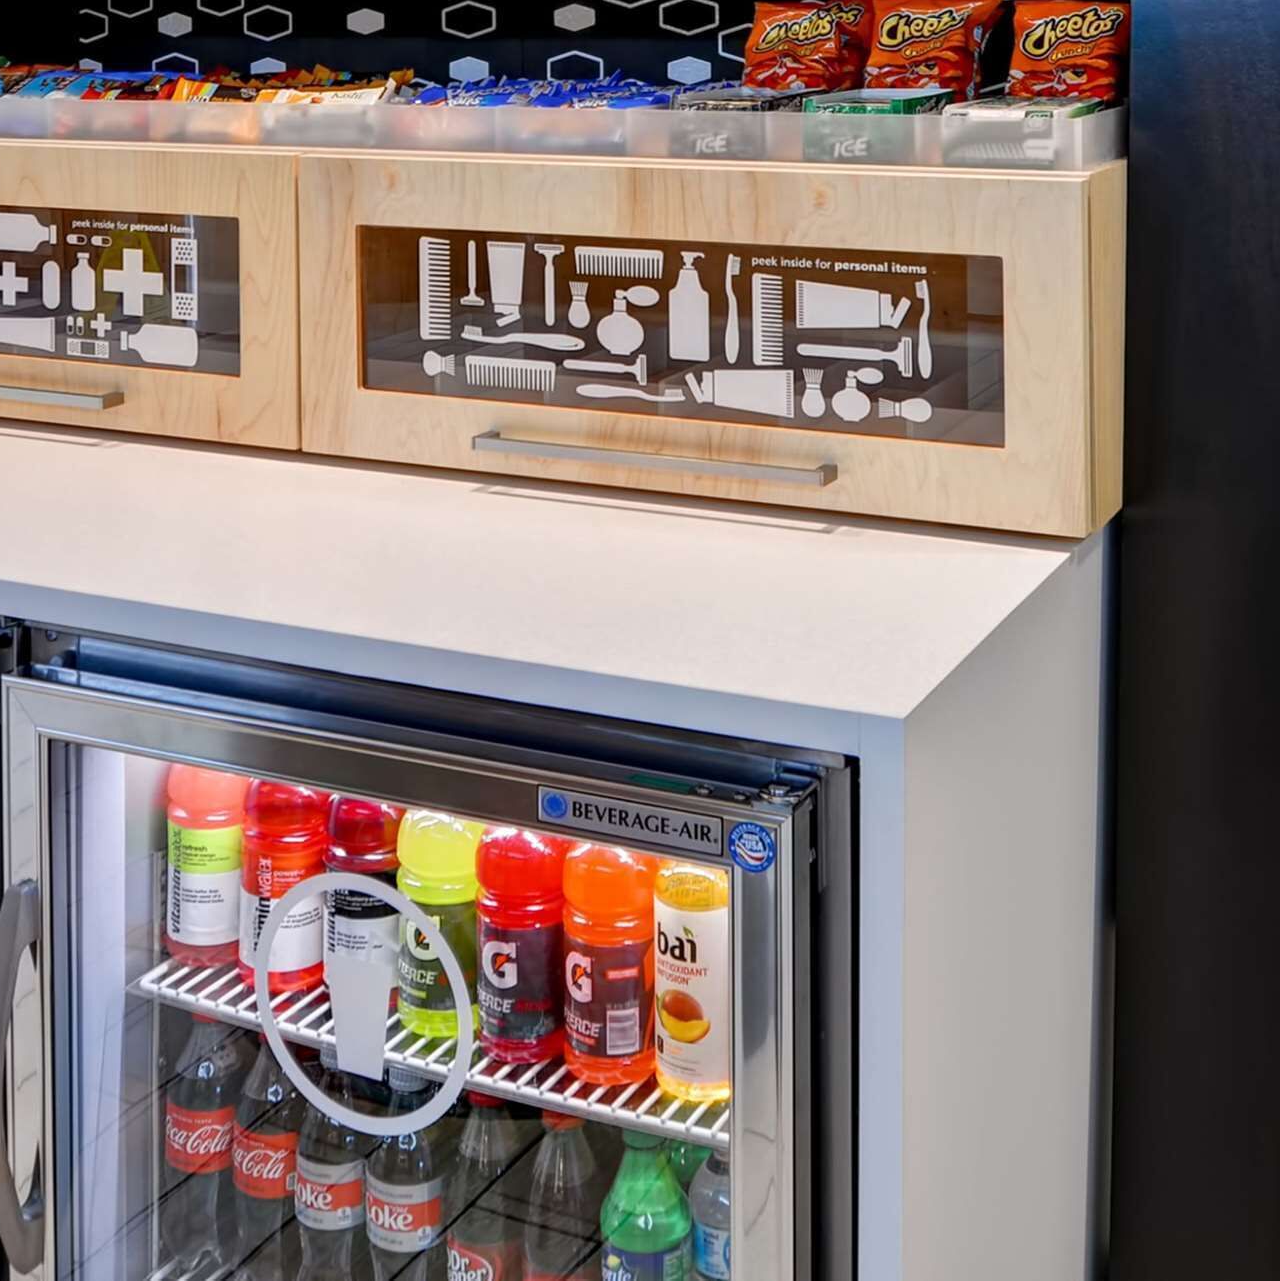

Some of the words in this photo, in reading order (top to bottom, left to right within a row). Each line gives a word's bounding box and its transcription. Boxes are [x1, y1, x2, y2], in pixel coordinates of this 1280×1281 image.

[1024, 11, 1120, 57] Cheetos
[695, 135, 728, 154] ICE
[833, 137, 869, 158] ICE
[72, 219, 91, 229] peek
[92, 220, 115, 230] inside
[116, 221, 129, 230] for
[129, 223, 168, 233] personal
[751, 256, 778, 267] peek
[780, 257, 813, 269] inside
[815, 258, 831, 269] for
[834, 261, 889, 272] personal
[891, 262, 928, 274] items
[572, 800, 712, 843] BEVERAGE-AIR
[657, 921, 698, 964] bai
[482, 940, 518, 990] G
[657, 958, 708, 977] ANTIOXIDANT
[565, 951, 593, 1003] G
[657, 967, 689, 986] INFUSION
